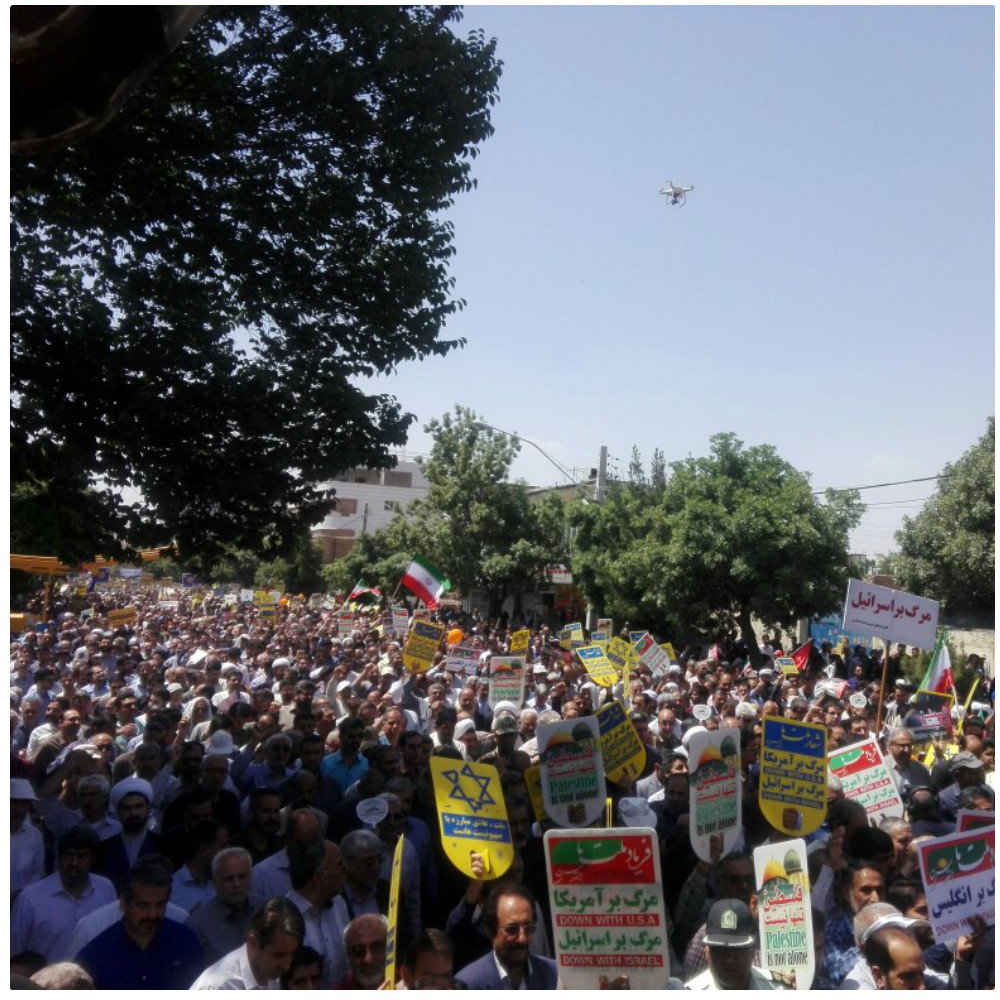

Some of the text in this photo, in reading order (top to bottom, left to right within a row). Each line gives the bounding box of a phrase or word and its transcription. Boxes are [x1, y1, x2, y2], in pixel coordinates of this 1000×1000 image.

[851, 592, 932, 624] مرگ بر اسرائیل
[764, 751, 794, 766] آمریکا
[796, 760, 804, 772] بر
[806, 758, 824, 774] مرگ
[550, 776, 598, 793] Palestine
[762, 777, 824, 798] مرگ بر اسرائیل
[560, 793, 574, 804] not
[697, 826, 703, 836] is
[553, 888, 658, 914] مرگ بر آمریکا
[764, 884, 802, 912] فلسطین
[932, 886, 972, 918] انگلیس
[976, 886, 985, 906] بر
[560, 914, 656, 926] DOWN WITH U.S.A
[764, 908, 804, 929] تنها نیست
[558, 930, 662, 952] مرگ بر اسرائیل
[766, 929, 807, 950] Palestine
[562, 955, 660, 966] DOWN WITH ISRAEL
[768, 950, 808, 966] is not alone
